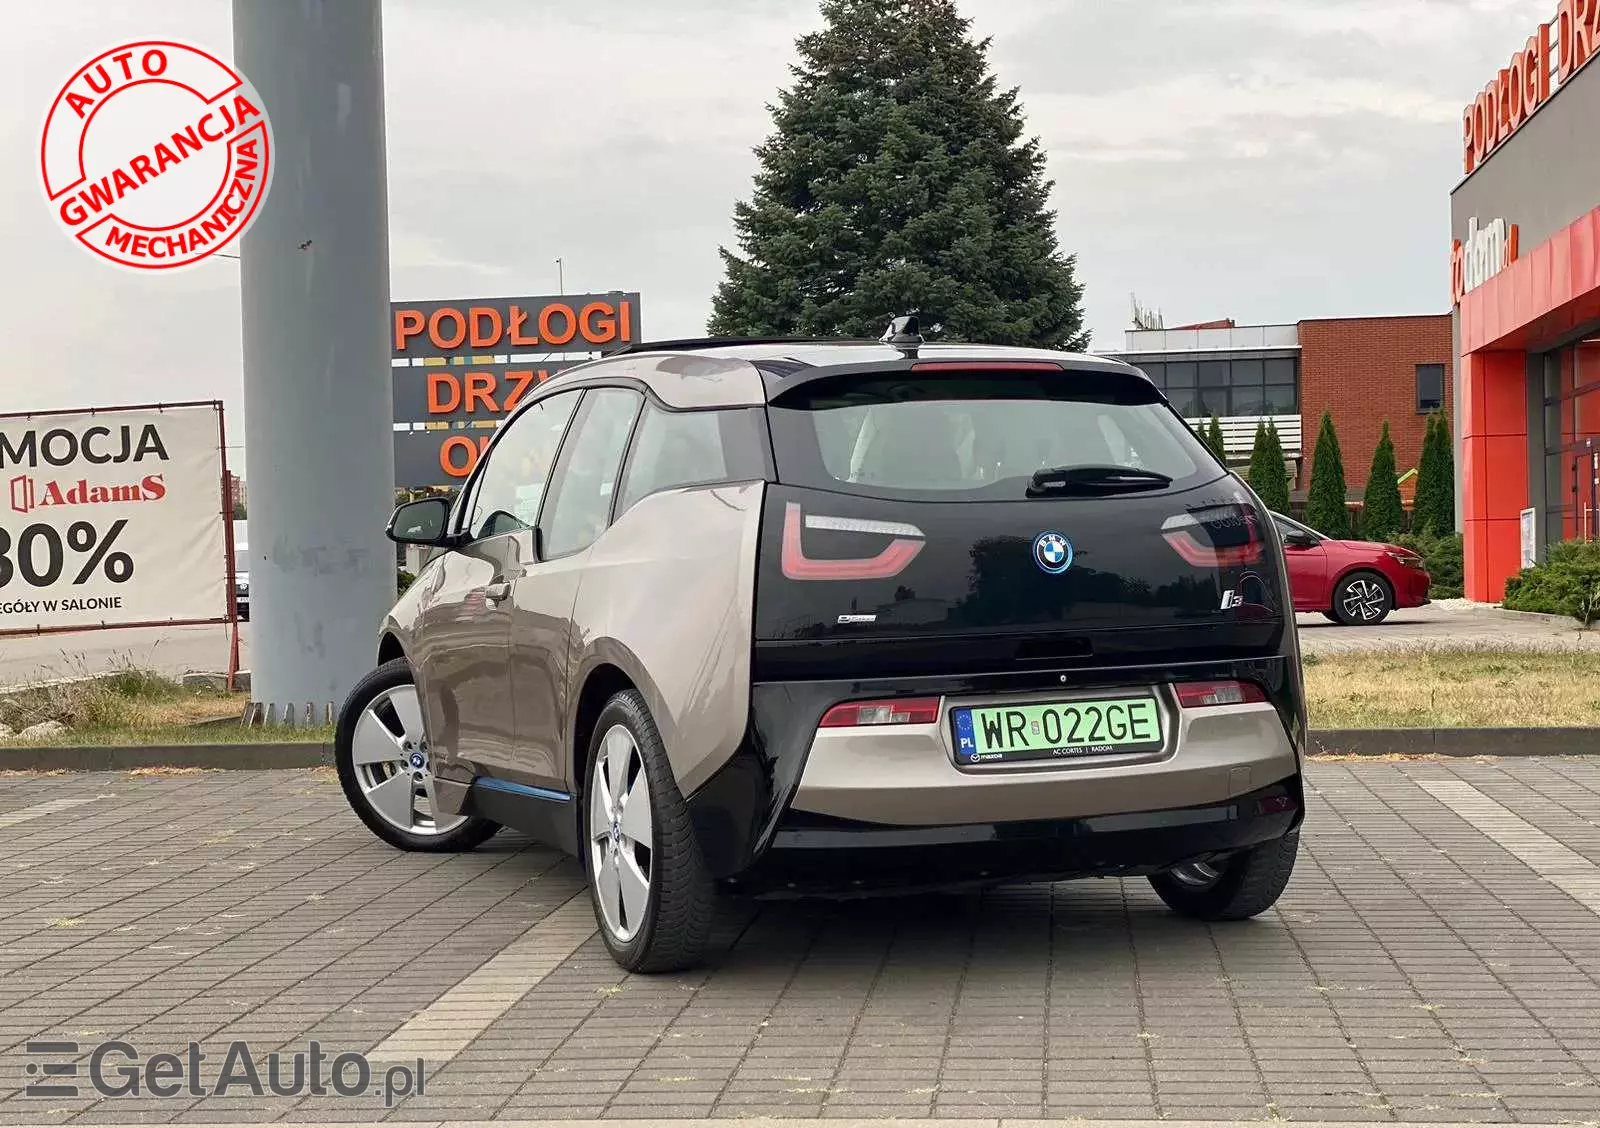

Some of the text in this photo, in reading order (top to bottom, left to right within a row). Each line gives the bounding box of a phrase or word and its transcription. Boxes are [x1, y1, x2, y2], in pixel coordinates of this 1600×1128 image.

[1463, 24, 1550, 175] PODŁOGI
[394, 301, 631, 350] PODŁOGI
[426, 369, 549, 414] DRZ
[0, 424, 170, 469] MOCJA
[439, 435, 490, 477] O
[38, 473, 167, 507] AdamS
[42, 599, 58, 612] W
[61, 596, 122, 611] SALONIE
[960, 737, 975, 749] PL
[980, 703, 1151, 749] WR 022GE
